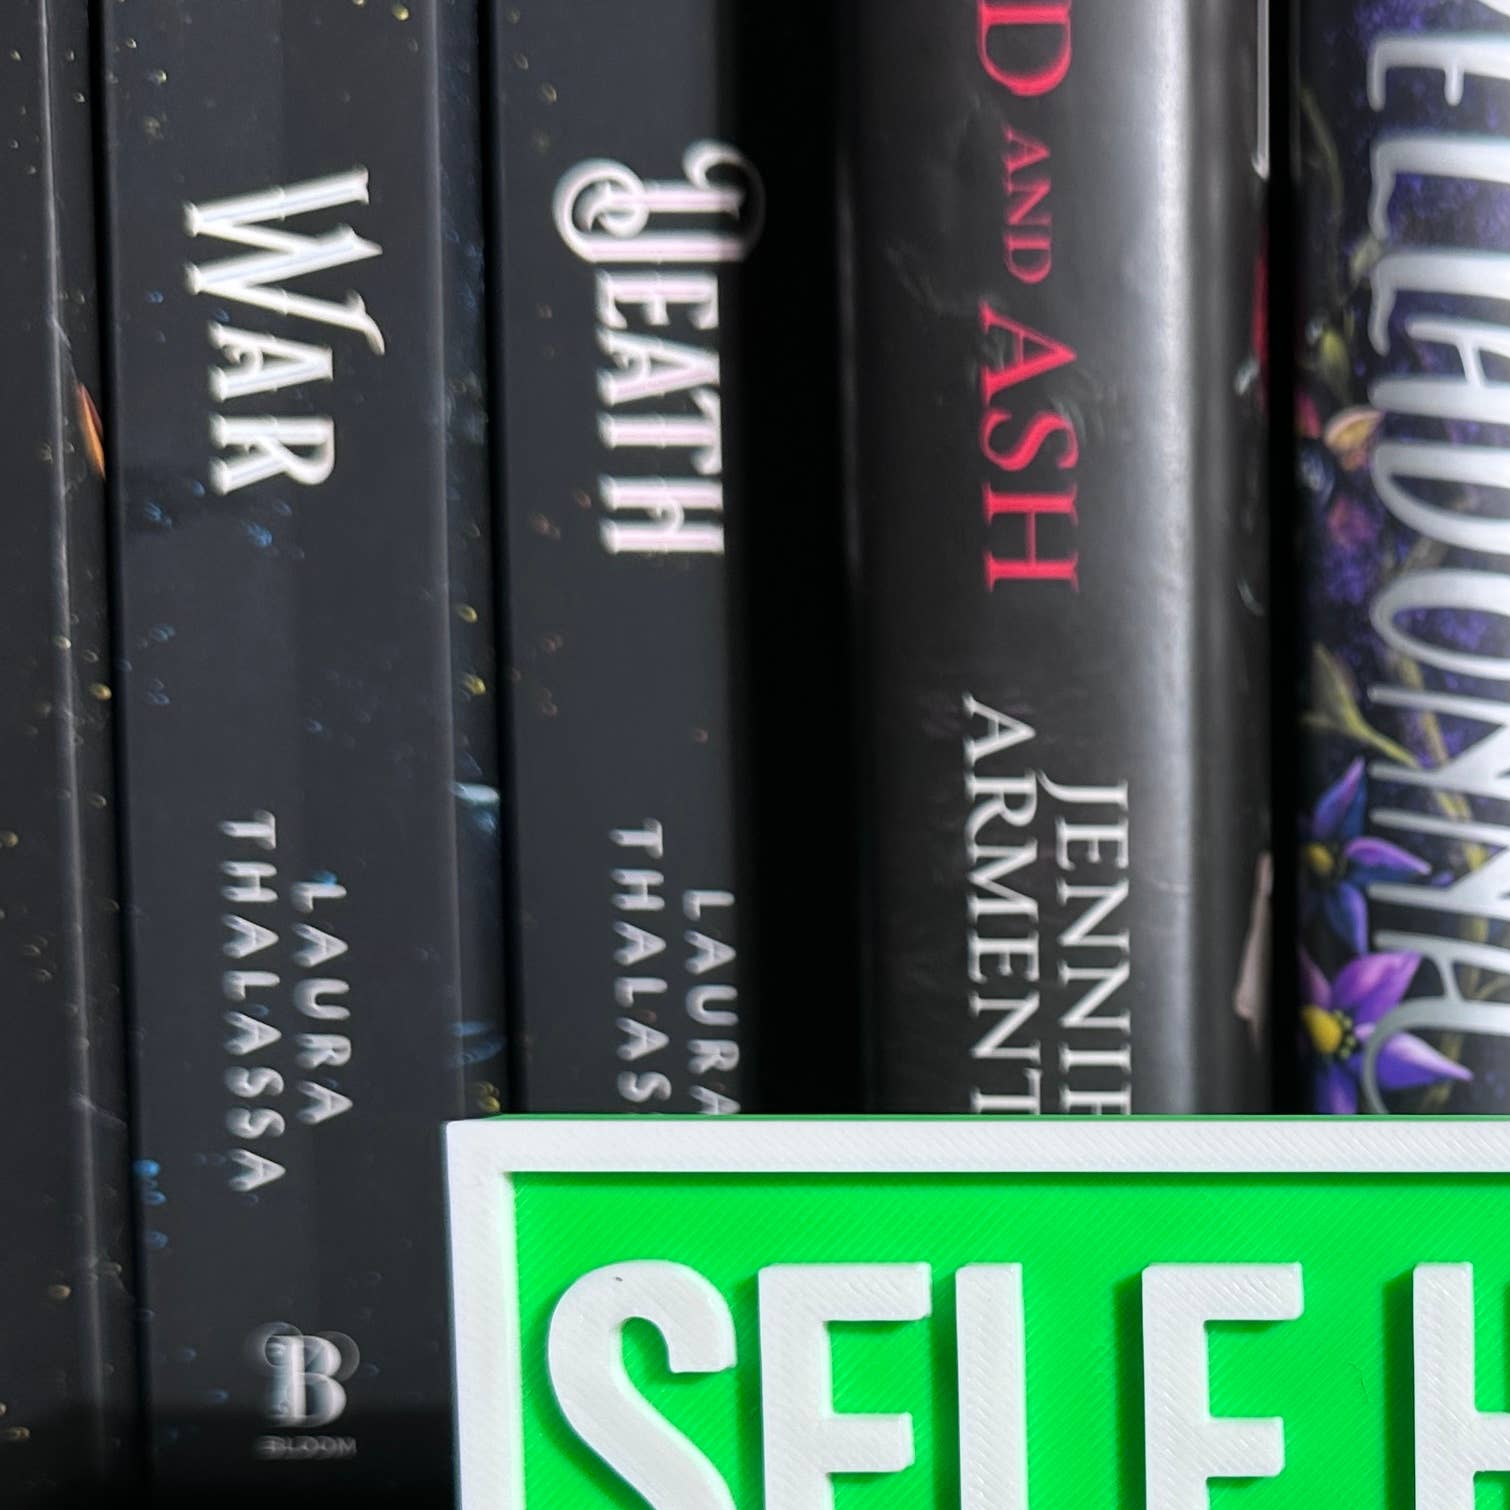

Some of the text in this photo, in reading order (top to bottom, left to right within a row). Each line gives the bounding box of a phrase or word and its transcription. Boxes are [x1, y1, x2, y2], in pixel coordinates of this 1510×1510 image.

[183, 165, 386, 496] WAR
[553, 140, 765, 555] DEATH
[1003, 125, 1053, 284] AND
[979, 302, 1078, 593] ASH
[219, 809, 286, 1193] THALASSA
[293, 880, 354, 1126] LAURA
[611, 817, 672, 1114] THALAS
[684, 889, 741, 1114] LAURA
[964, 690, 1041, 1114] ARMENT
